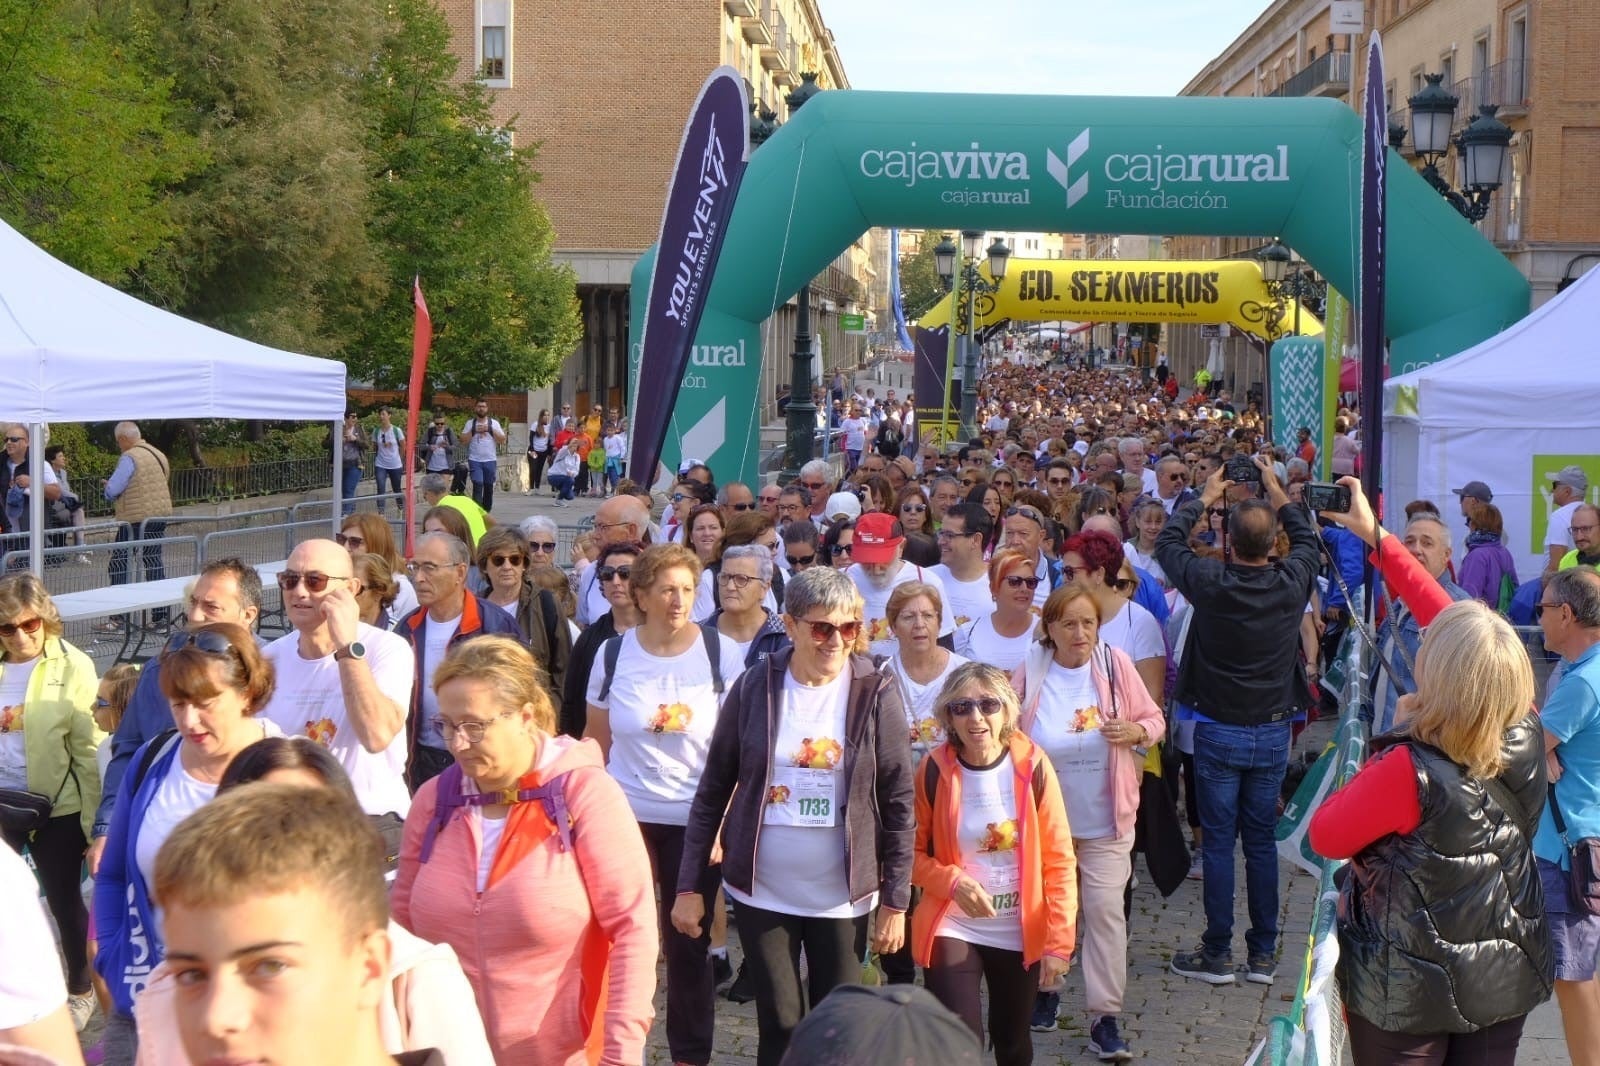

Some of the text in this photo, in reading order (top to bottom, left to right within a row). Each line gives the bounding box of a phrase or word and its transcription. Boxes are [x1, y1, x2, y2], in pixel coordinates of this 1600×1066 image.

[860, 141, 1031, 187] cajaviva
[1104, 144, 1290, 191] cajarural
[941, 187, 1031, 206] cajarural
[1105, 190, 1229, 209] Fundación
[680, 220, 717, 328] SPORTS SERVICES
[1069, 270, 1219, 308] SEXMEROS
[1039, 308, 1081, 316] Comunidad
[798, 798, 831, 816] 1733
[992, 890, 1020, 911] 1732
